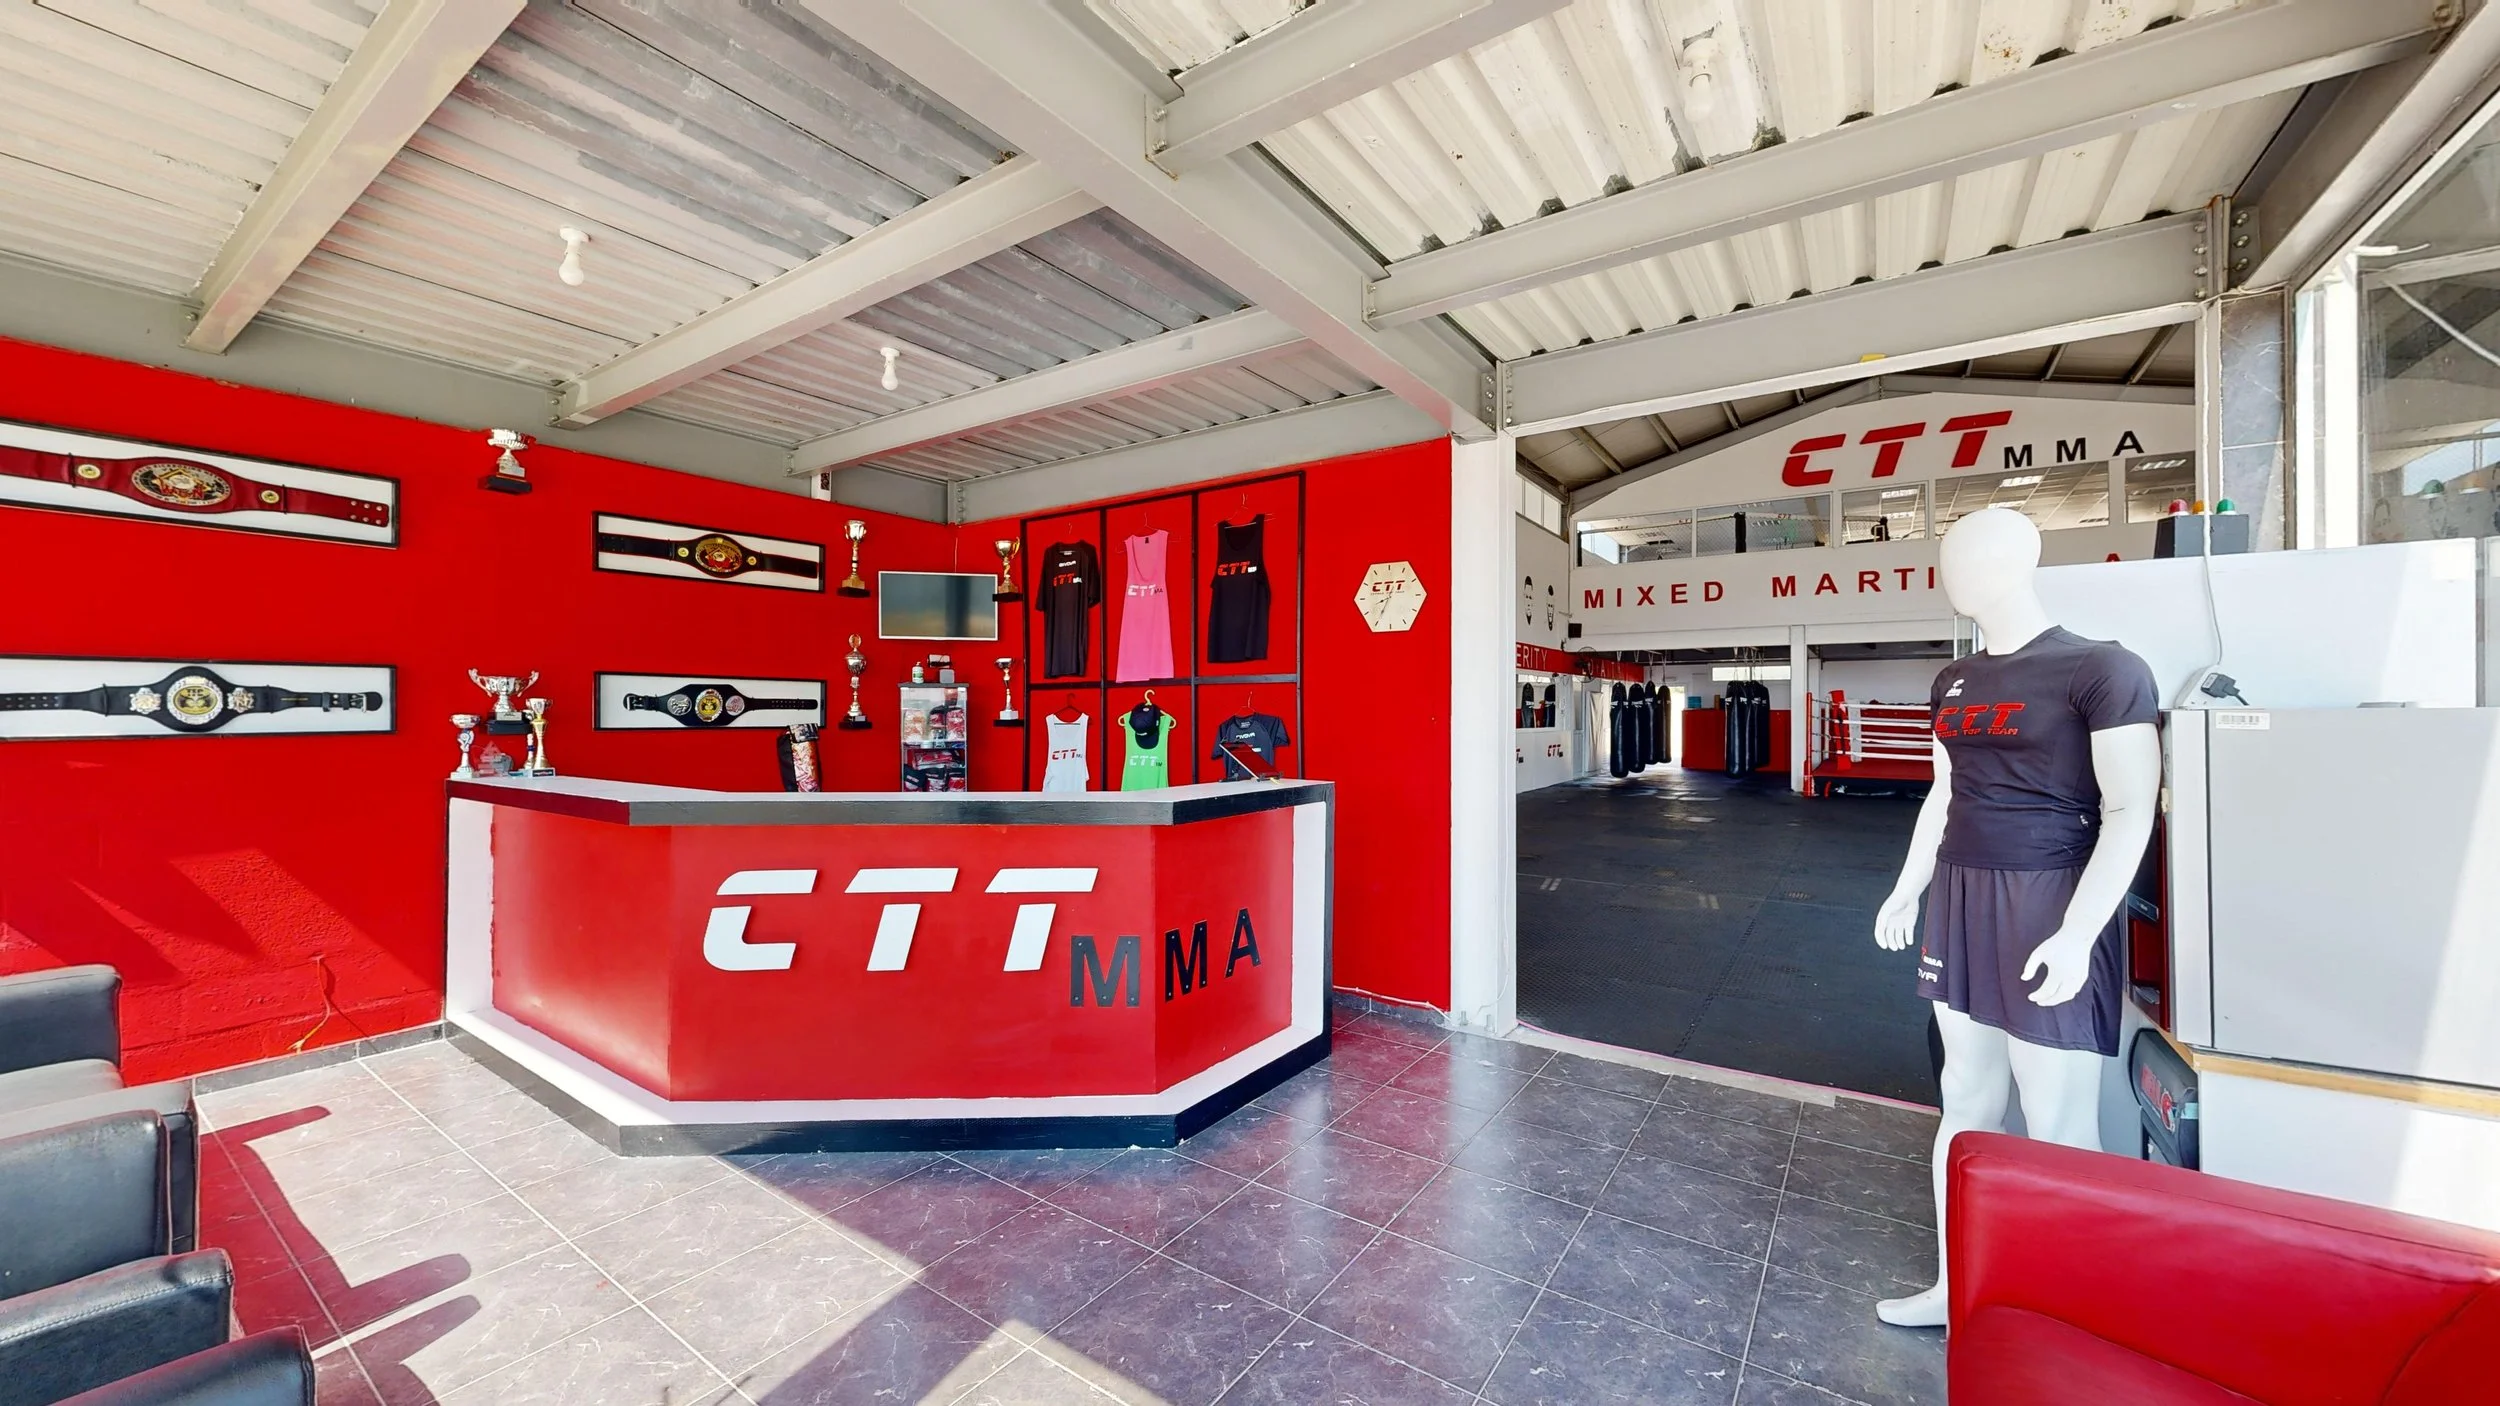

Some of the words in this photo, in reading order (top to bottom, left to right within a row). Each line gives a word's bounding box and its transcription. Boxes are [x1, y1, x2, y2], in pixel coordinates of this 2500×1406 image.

[1781, 410, 2013, 487] CTT
[2003, 430, 2145, 469] MMA
[1218, 561, 1250, 576] CTT
[1128, 584, 1156, 597] CTT
[1372, 580, 1406, 592] CTT
[1584, 581, 1724, 609] MIXED
[1771, 567, 1935, 598] MARTI
[1516, 645, 1548, 670] ERITY
[1935, 703, 2026, 731] CTT
[1052, 749, 1077, 760] CTT
[1129, 755, 1159, 766] CTT
[703, 867, 1098, 972] CTT
[1071, 907, 1261, 1007] MMA
